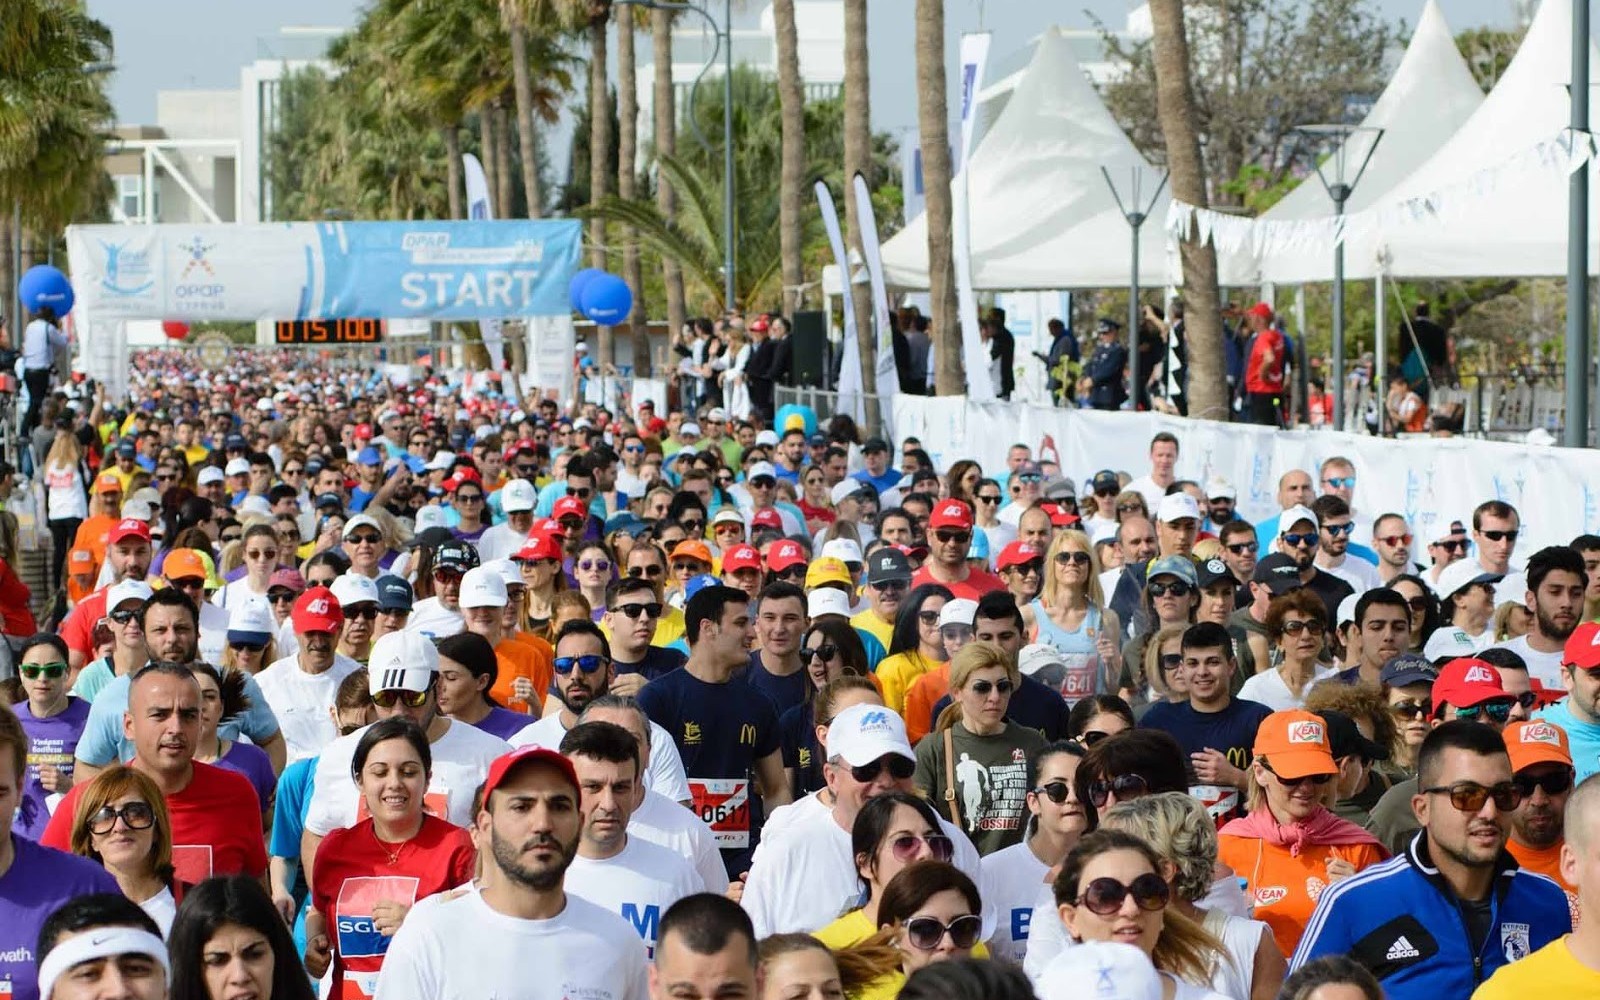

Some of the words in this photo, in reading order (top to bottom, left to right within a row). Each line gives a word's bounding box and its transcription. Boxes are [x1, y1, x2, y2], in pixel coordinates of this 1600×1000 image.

[401, 270, 538, 307] START
[305, 598, 330, 615] 4G
[1463, 665, 1494, 682] 4G
[1292, 723, 1321, 741] KEAN
[1523, 725, 1556, 741] KEAN
[994, 781, 1003, 789] IS
[991, 789, 1002, 800] OF
[992, 800, 1010, 809] THAT
[1010, 799, 1024, 809] SAYS
[1254, 888, 1284, 903] KEAN
[1386, 949, 1419, 960] adidas
